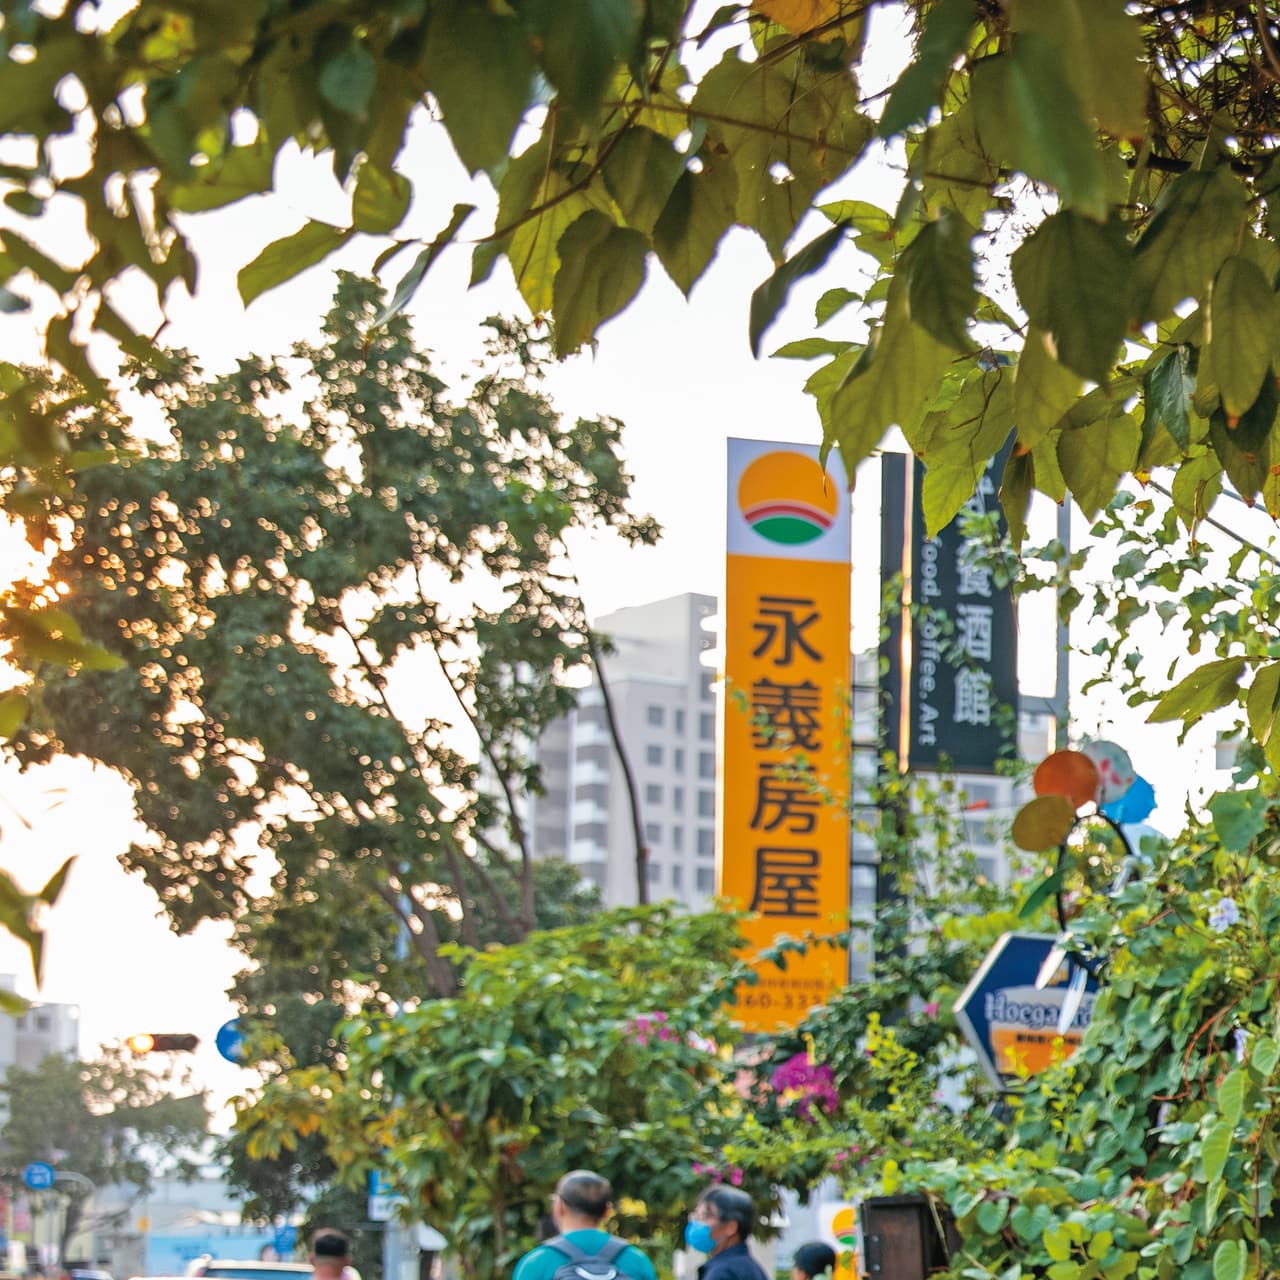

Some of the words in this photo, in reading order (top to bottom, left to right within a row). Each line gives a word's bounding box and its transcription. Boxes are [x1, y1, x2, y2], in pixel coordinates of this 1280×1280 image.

[750, 596, 823, 918] 永義房屋
[918, 708, 940, 746] Art
